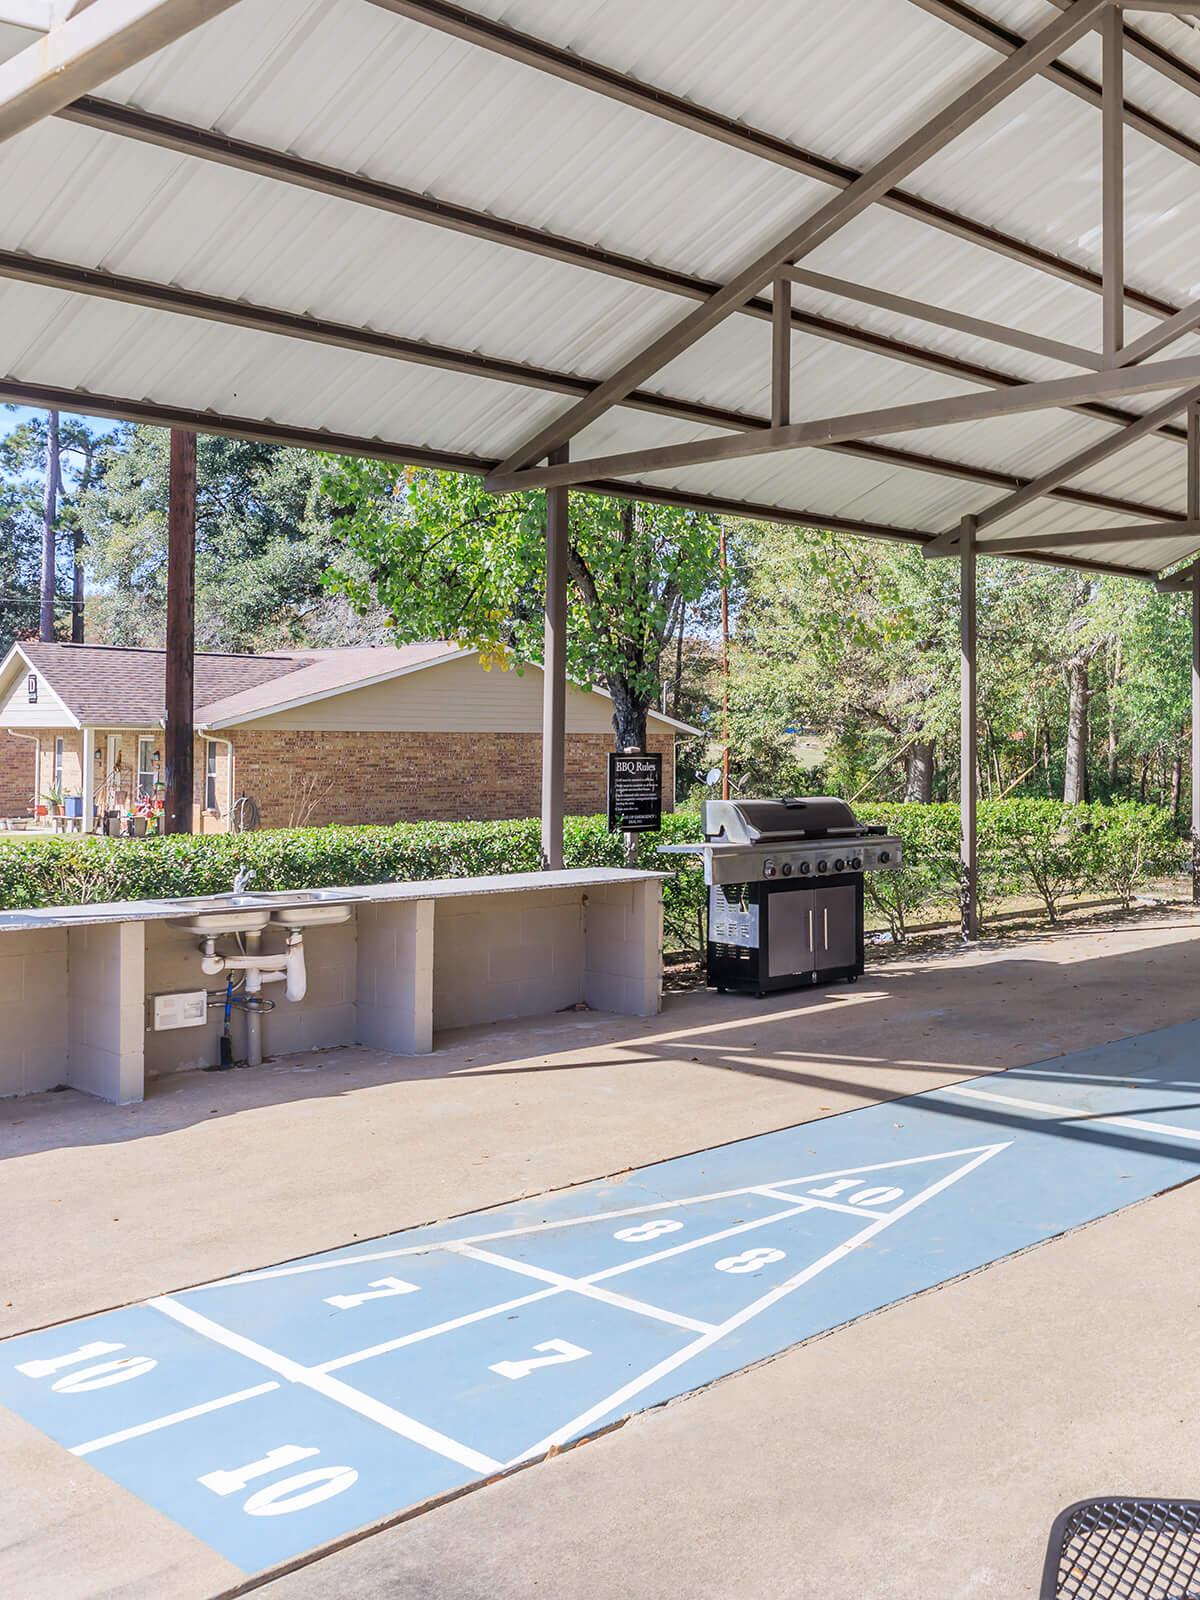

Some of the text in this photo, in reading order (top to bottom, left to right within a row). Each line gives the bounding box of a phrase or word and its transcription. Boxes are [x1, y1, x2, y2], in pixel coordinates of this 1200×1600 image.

[616, 761, 656, 774] BBQ Rules
[810, 1178, 904, 1208] 10
[611, 1218, 684, 1244] 8
[713, 1246, 787, 1275] 8
[322, 1275, 422, 1310] 7
[13, 1340, 160, 1394] 10
[487, 1337, 592, 1381] 7
[197, 1443, 360, 1518] 10
